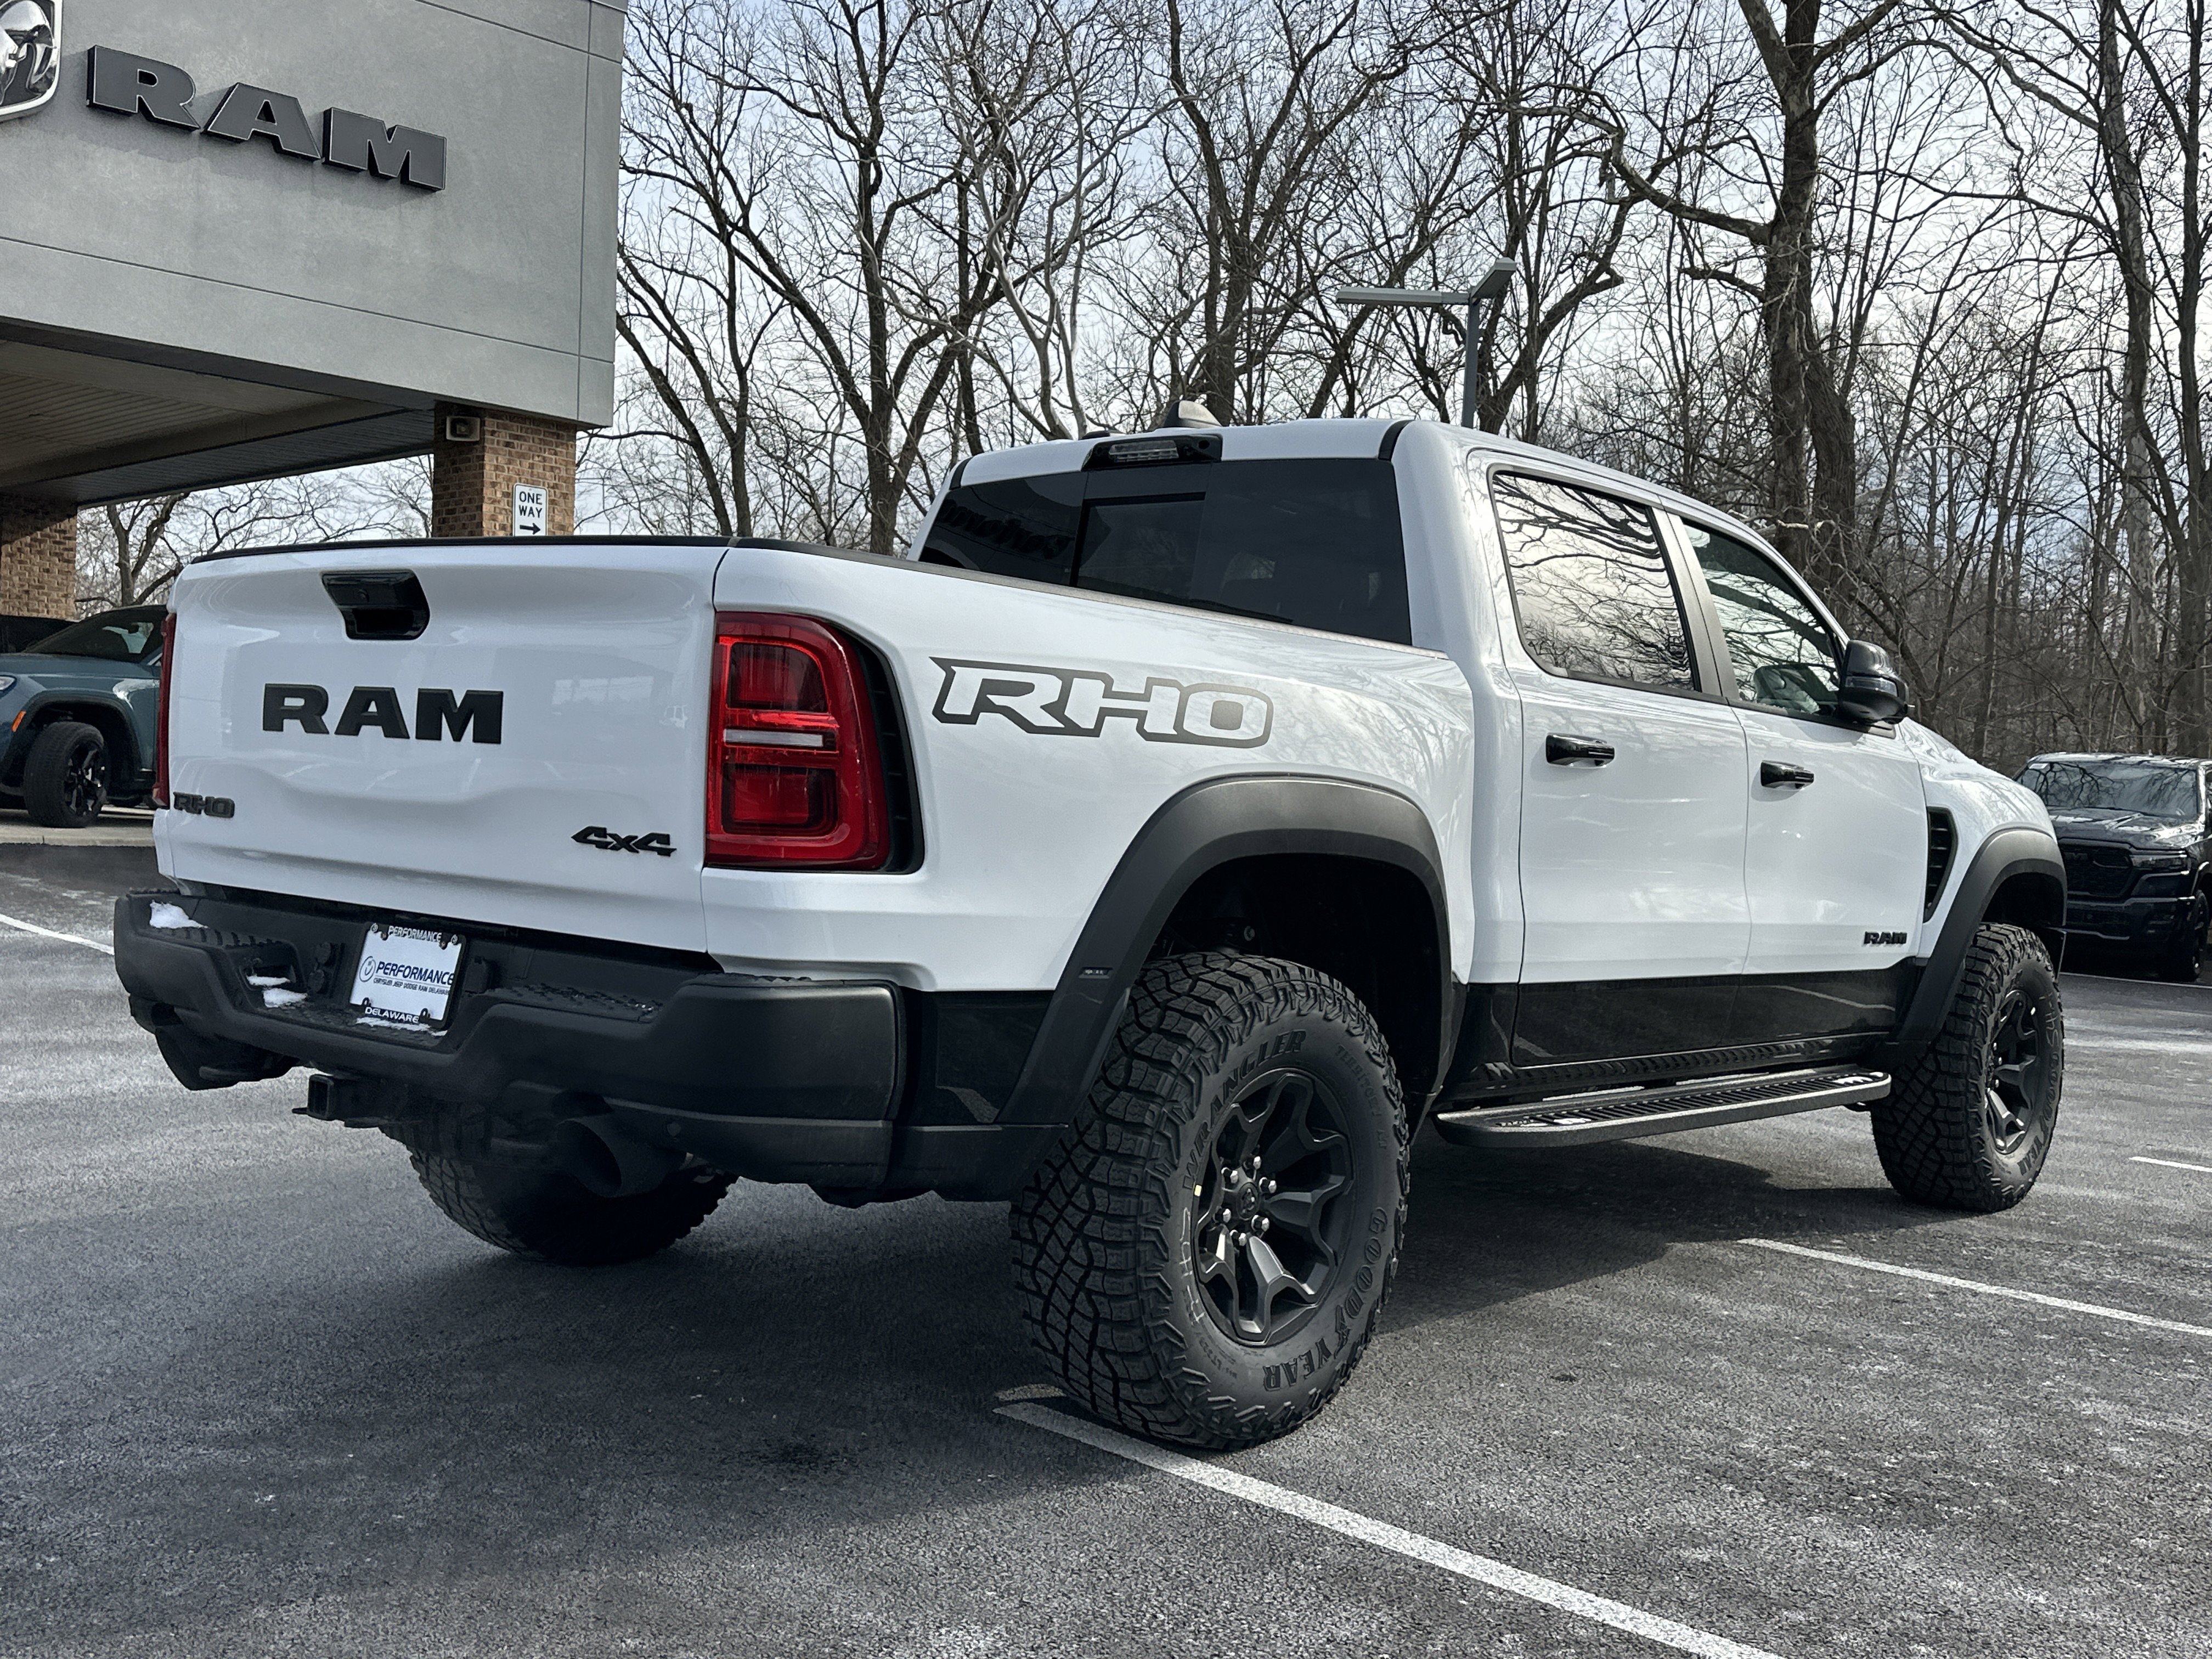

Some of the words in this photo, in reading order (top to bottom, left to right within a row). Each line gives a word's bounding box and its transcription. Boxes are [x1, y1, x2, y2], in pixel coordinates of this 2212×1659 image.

[87, 45, 447, 191] RAM
[519, 492, 542, 505] ONE
[518, 505, 542, 518] WAY
[262, 683, 504, 744] RAM
[929, 657, 1274, 749] RHO
[173, 792, 235, 818] RHO
[388, 926, 442, 943] PERFORMANCE
[1863, 931, 1908, 945] RAM
[376, 961, 454, 985] PERFORMANCE
[365, 1007, 419, 1023] DELAWARE
[1183, 1029, 1307, 1190] WRANGLER
